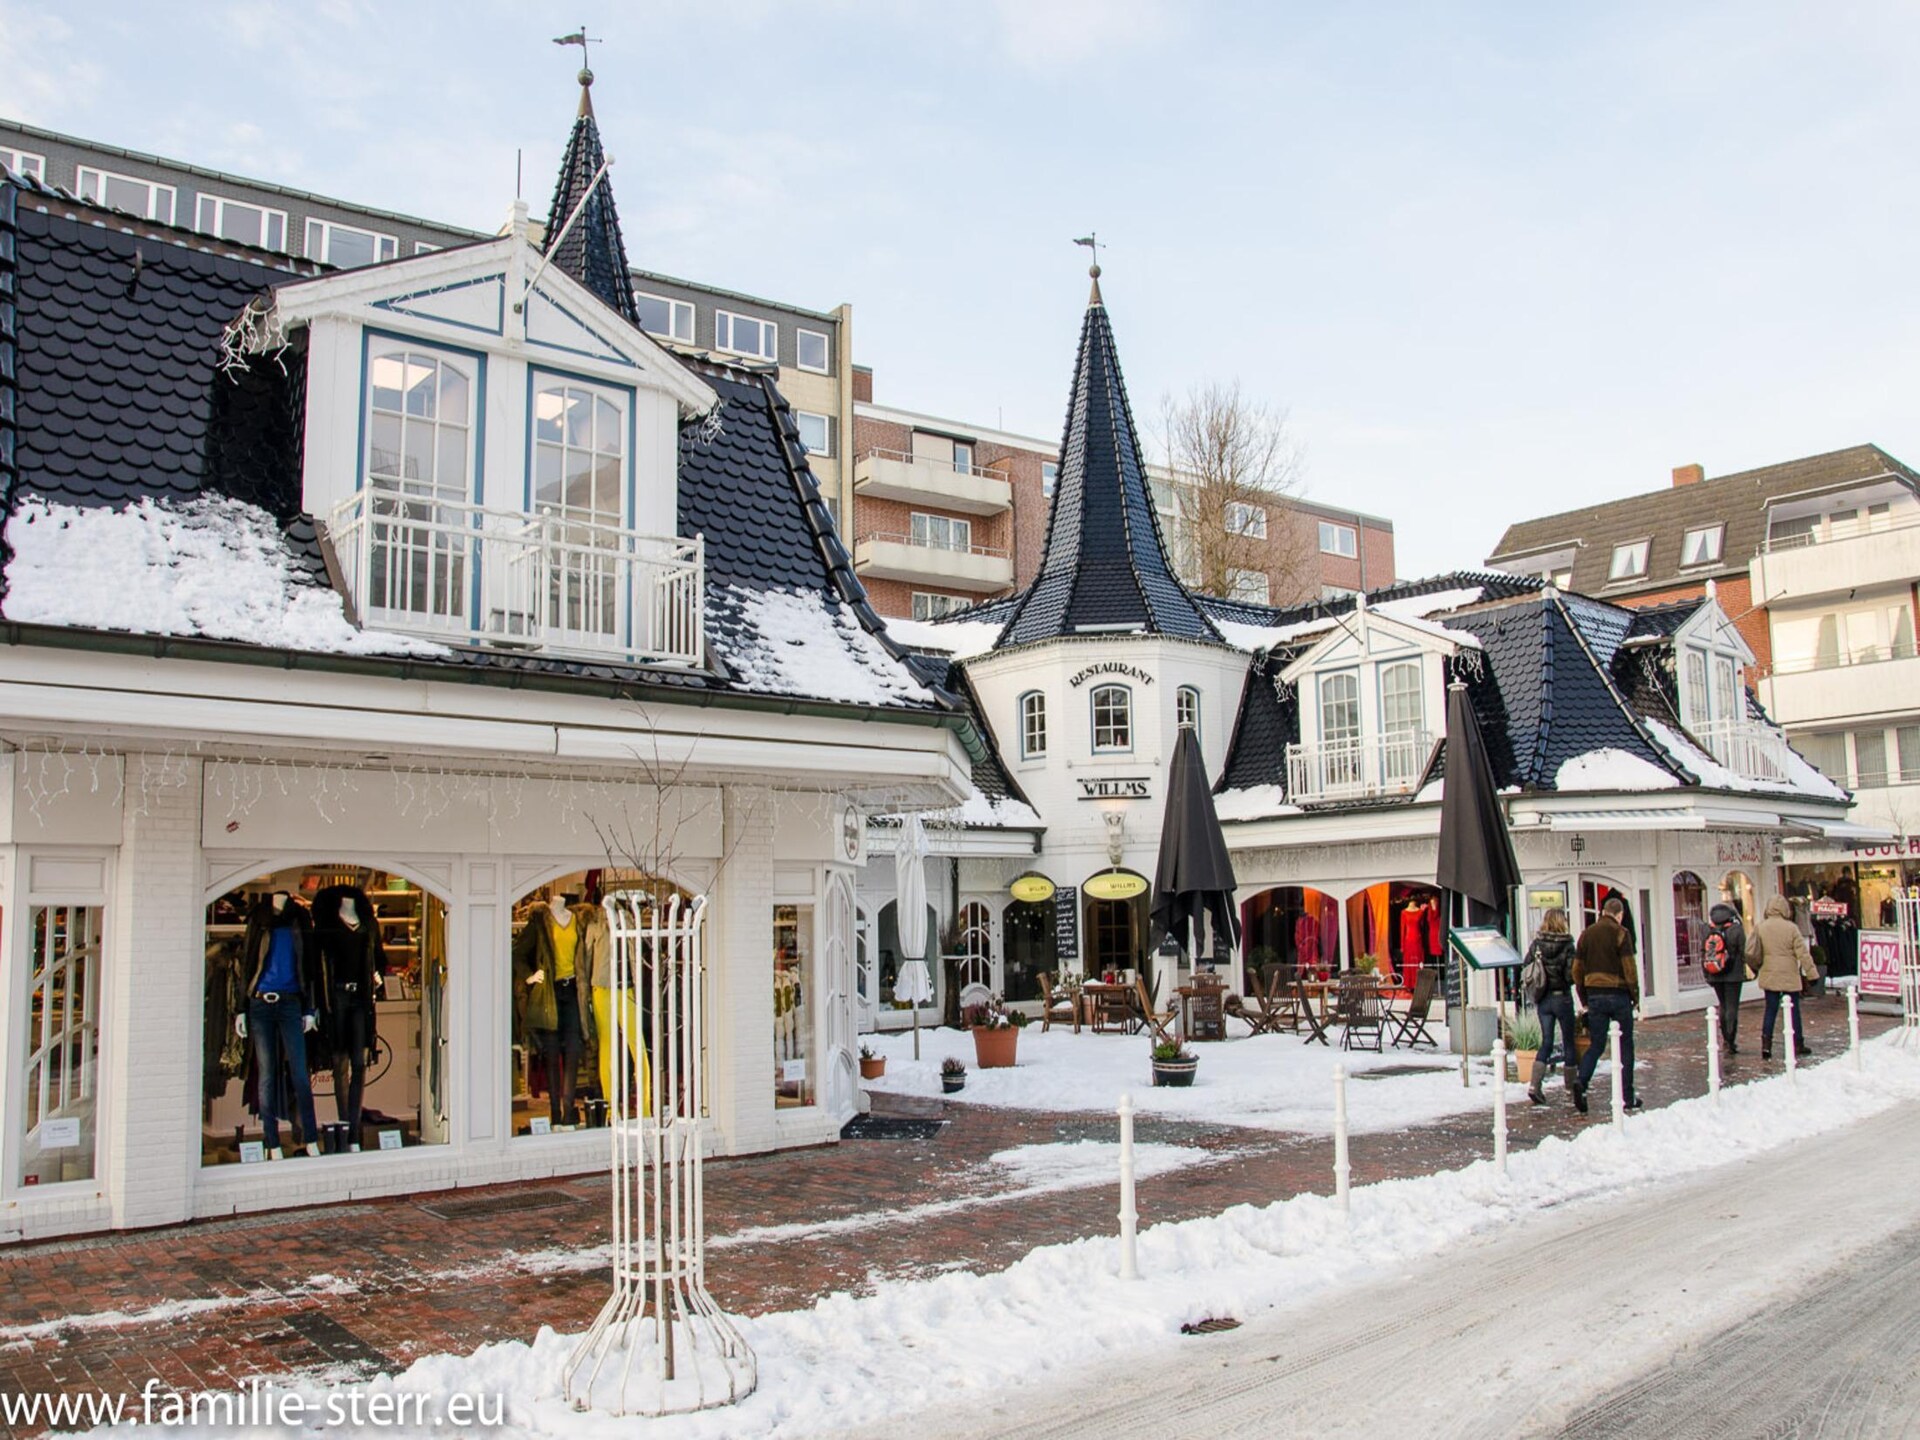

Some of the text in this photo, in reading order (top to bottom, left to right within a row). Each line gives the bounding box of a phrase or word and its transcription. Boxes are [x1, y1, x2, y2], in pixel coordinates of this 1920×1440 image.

[1069, 662, 1155, 688] RESTAURANT
[1083, 782, 1147, 796] WILLMS
[1861, 943, 1899, 974] 30%
